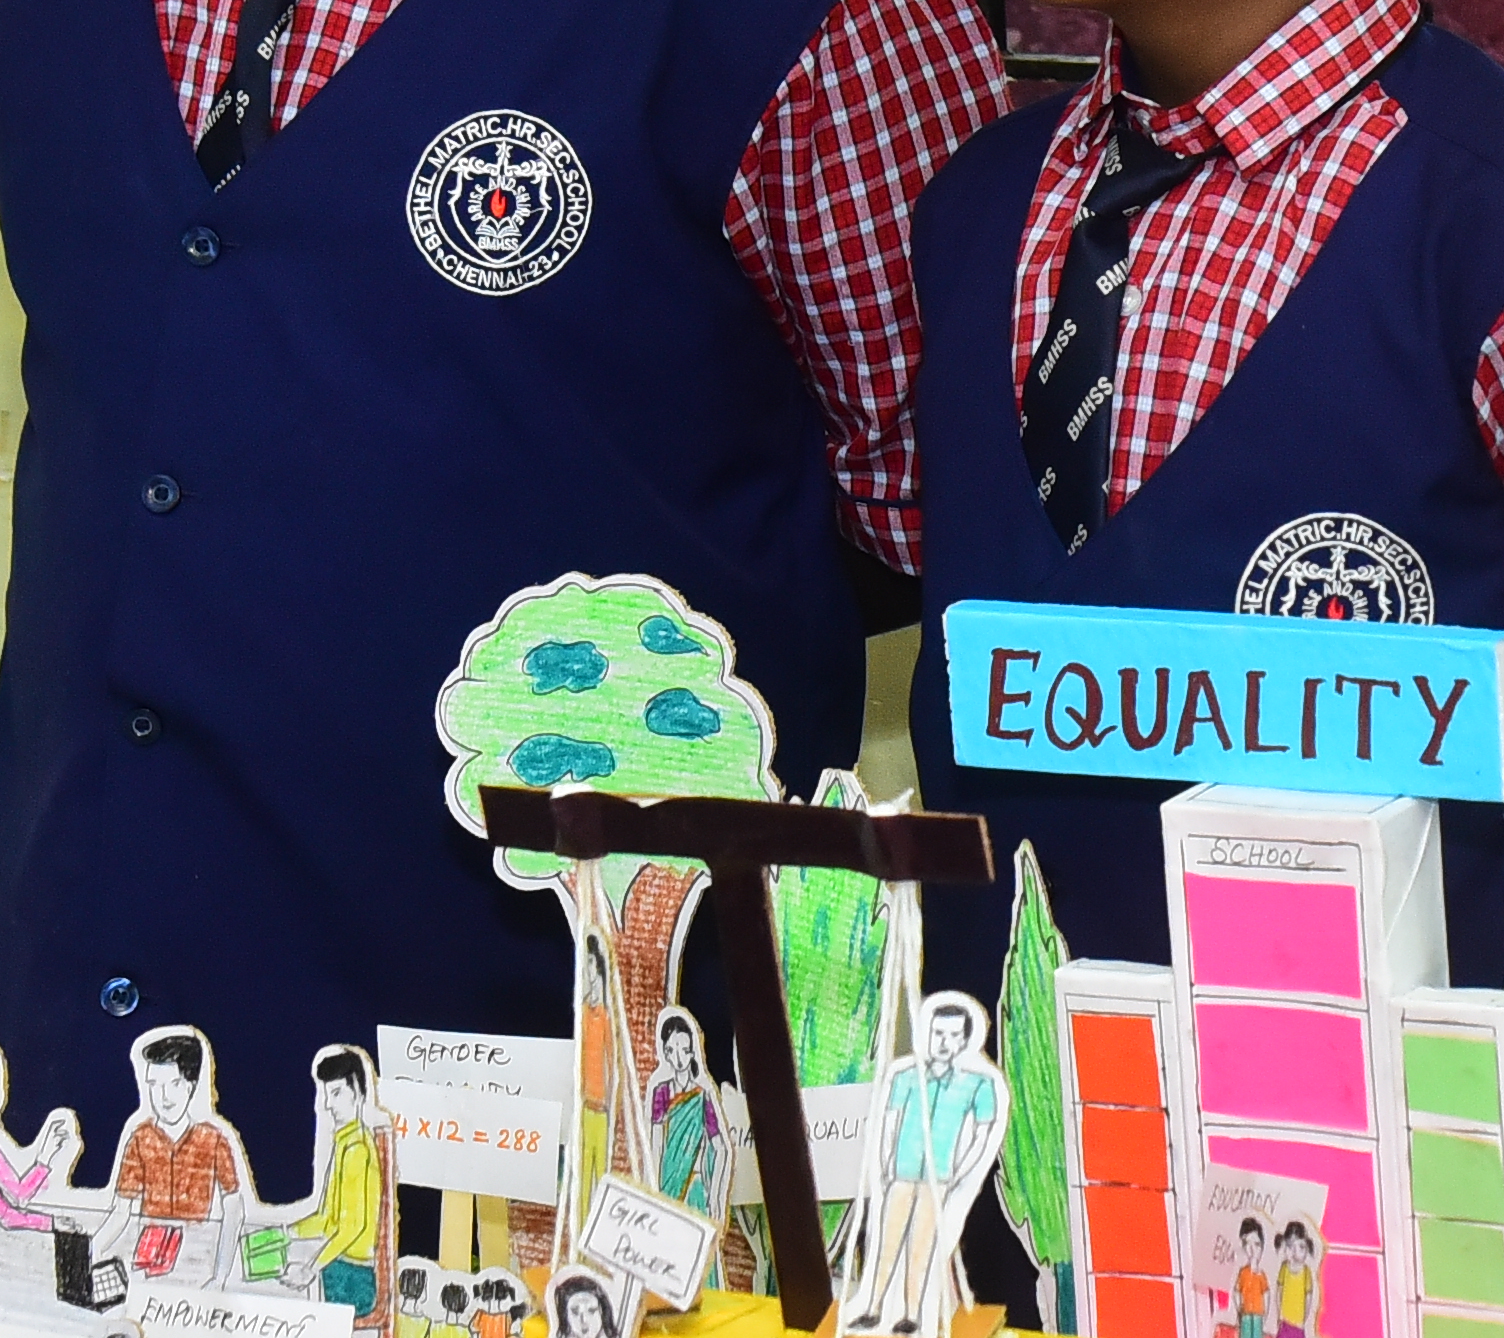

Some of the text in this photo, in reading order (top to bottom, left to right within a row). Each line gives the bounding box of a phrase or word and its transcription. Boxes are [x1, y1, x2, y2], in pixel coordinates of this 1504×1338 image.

[413, 166, 443, 252] BETHEL
[552, 168, 586, 250] SCHOOL
[468, 176, 532, 226] ARISE AND SHINE
[478, 237, 519, 250] BMHSS
[1038, 318, 1078, 385] BMHSS
[1066, 376, 1115, 441] BMHSS
[1243, 579, 1270, 615] HEL
[1323, 581, 1353, 597] AND
[985, 648, 1471, 766] EQUALITY
[1210, 837, 1317, 869] SCHOOL
[407, 1035, 512, 1071] GENDER
[496, 1128, 542, 1154] 288
[608, 1195, 660, 1237] GIRL
[1208, 1183, 1281, 1215] EDUCATION
[613, 1234, 681, 1281] POWER
